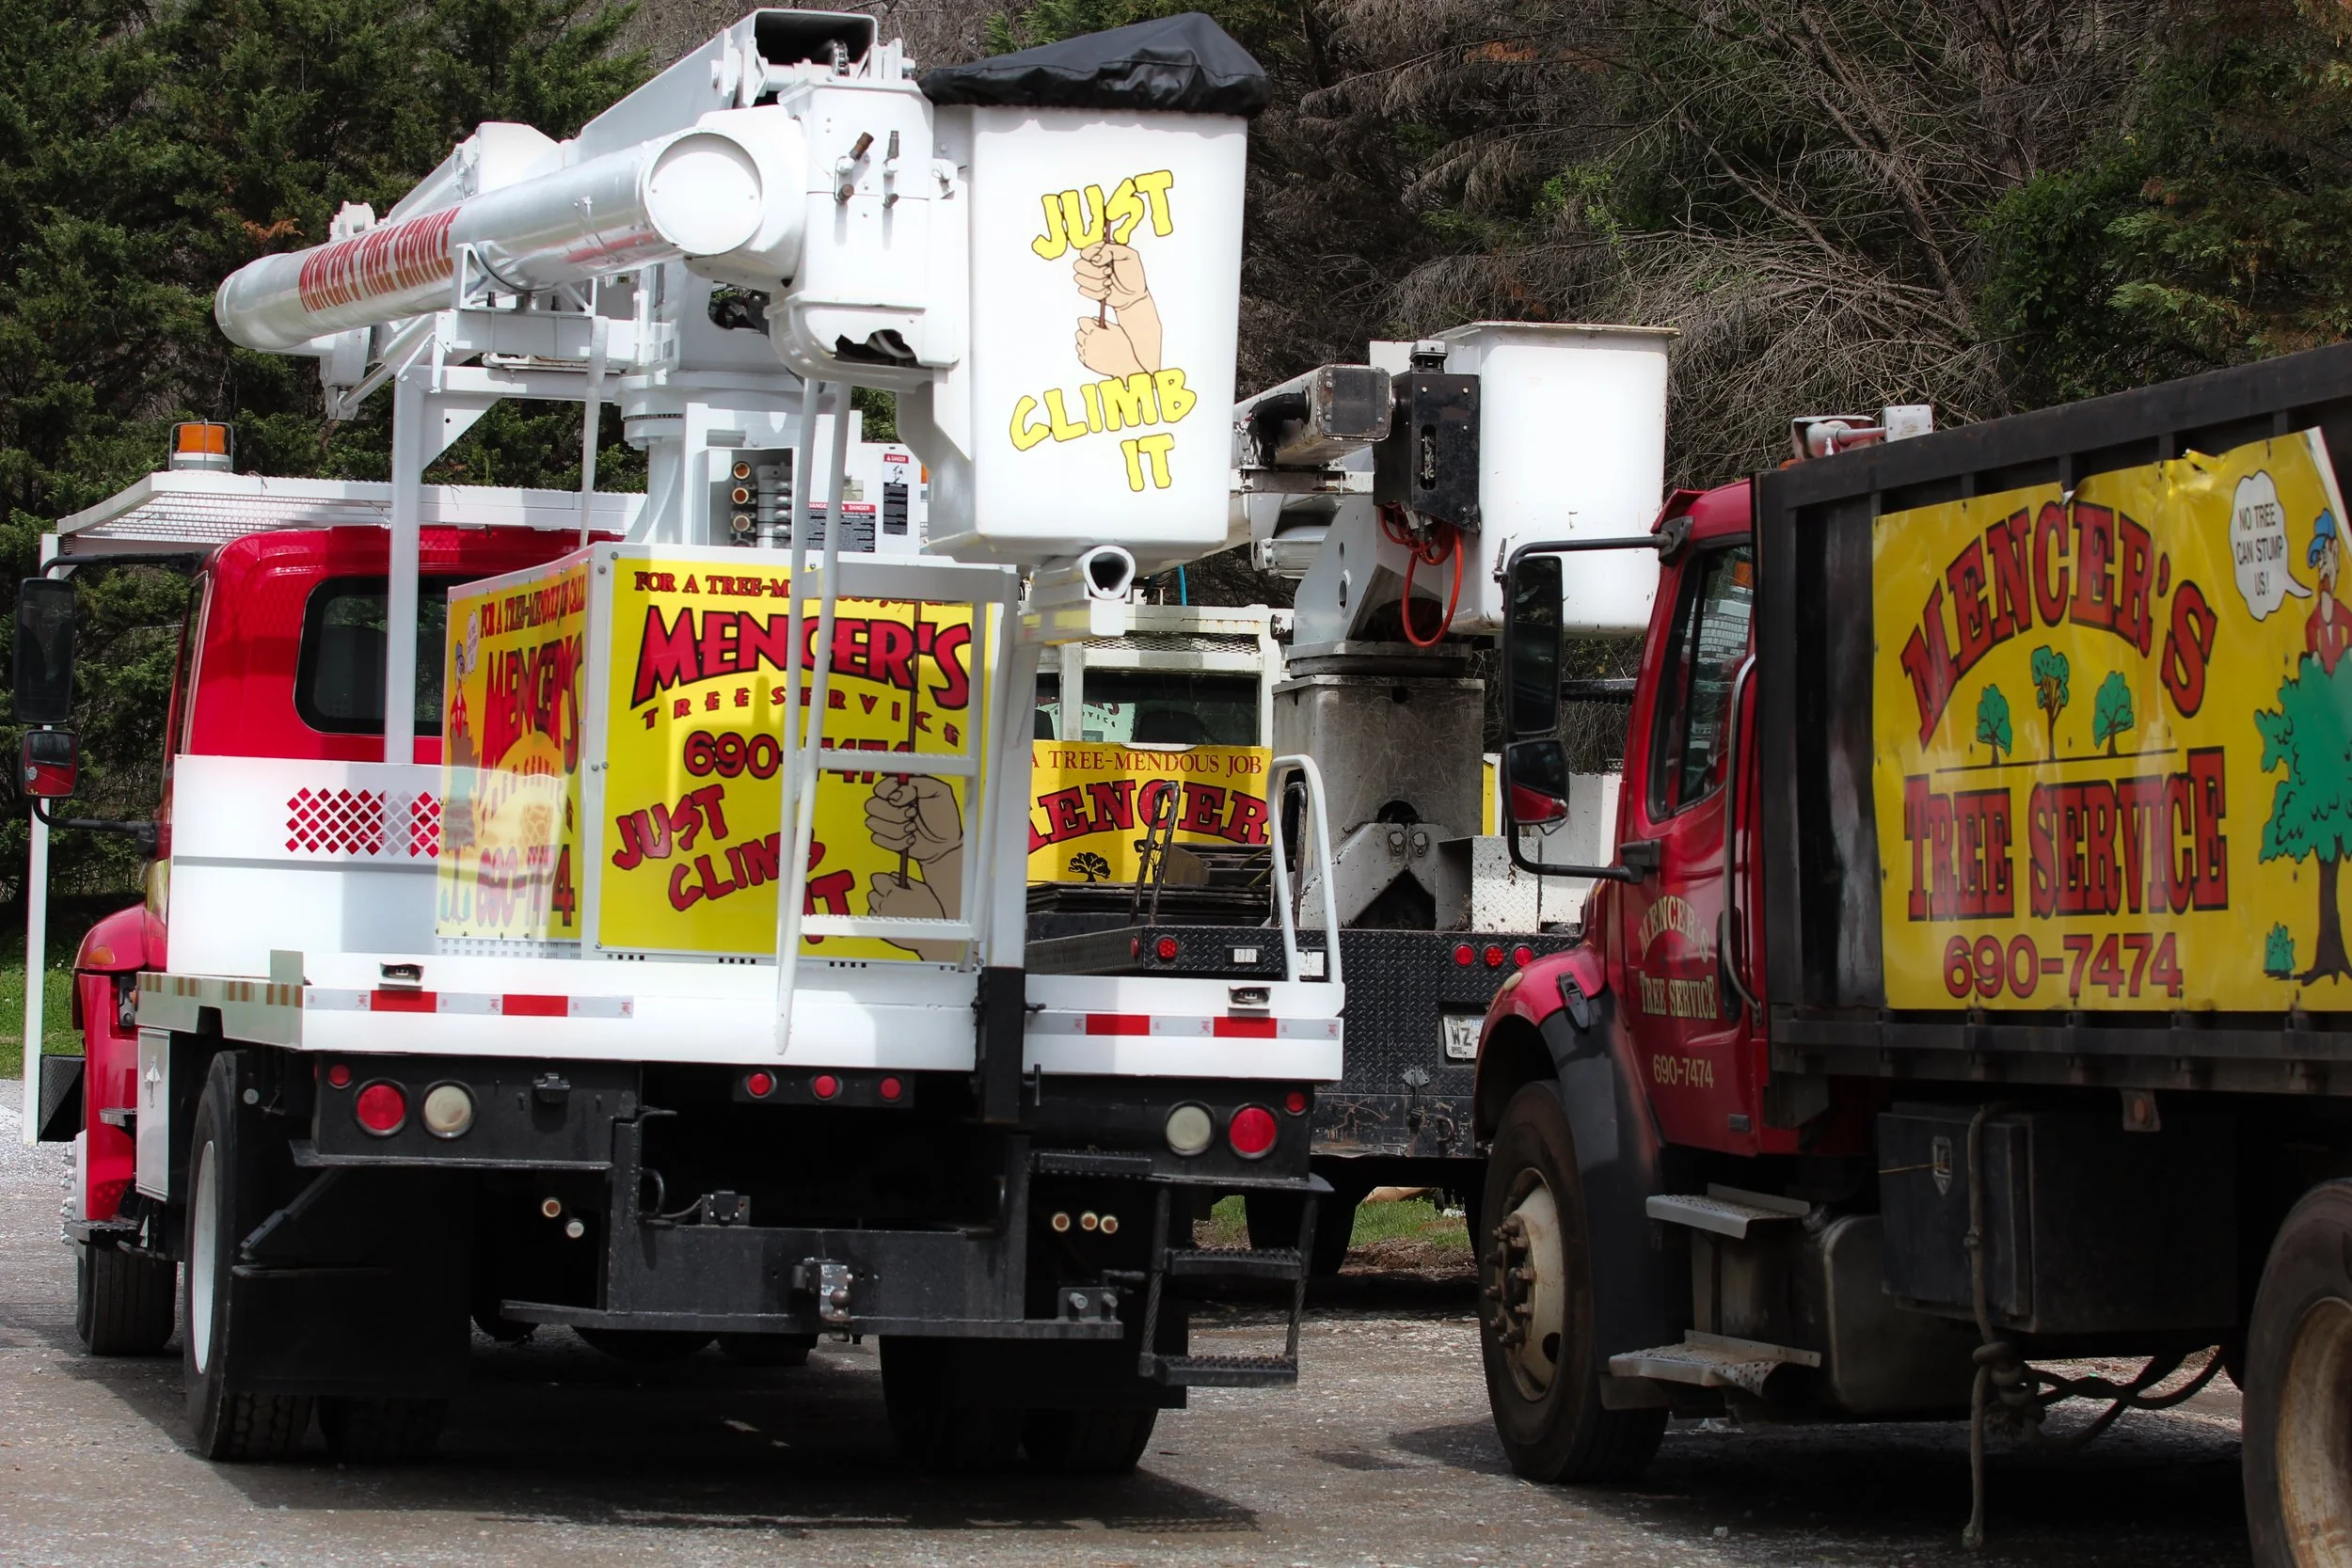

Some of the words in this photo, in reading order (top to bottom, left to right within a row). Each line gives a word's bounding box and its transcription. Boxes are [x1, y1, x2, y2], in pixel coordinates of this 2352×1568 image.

[1031, 169, 1173, 261] JUST
[360, 225, 403, 298] TREE
[393, 206, 463, 291] SERVICE
[1009, 368, 1197, 451] CLIMB
[1120, 433, 1175, 492] IT
[2238, 507, 2252, 531] NO
[2253, 502, 2277, 530] TREE
[2235, 542, 2254, 565] CAN
[2255, 534, 2283, 562] STUMP
[634, 571, 676, 593] FOR
[683, 578, 701, 594] A
[2254, 571, 2270, 596] US!
[496, 598, 502, 635] A
[1900, 500, 2218, 752] MENCER'S
[642, 688, 750, 731] TREE
[1048, 751, 1220, 773] TREE-MENDOUS
[1225, 754, 1263, 778] JOB
[612, 783, 729, 871] JUST
[1904, 773, 2015, 922] TREE
[2027, 745, 2229, 920] SERVICE
[1637, 895, 1710, 964] MENCER'S
[1944, 931, 2184, 1000] 690-7474
[1639, 970, 1667, 1016] TREE
[1669, 974, 1717, 1020] SERVICE
[1652, 1053, 1715, 1089] 690-7474
